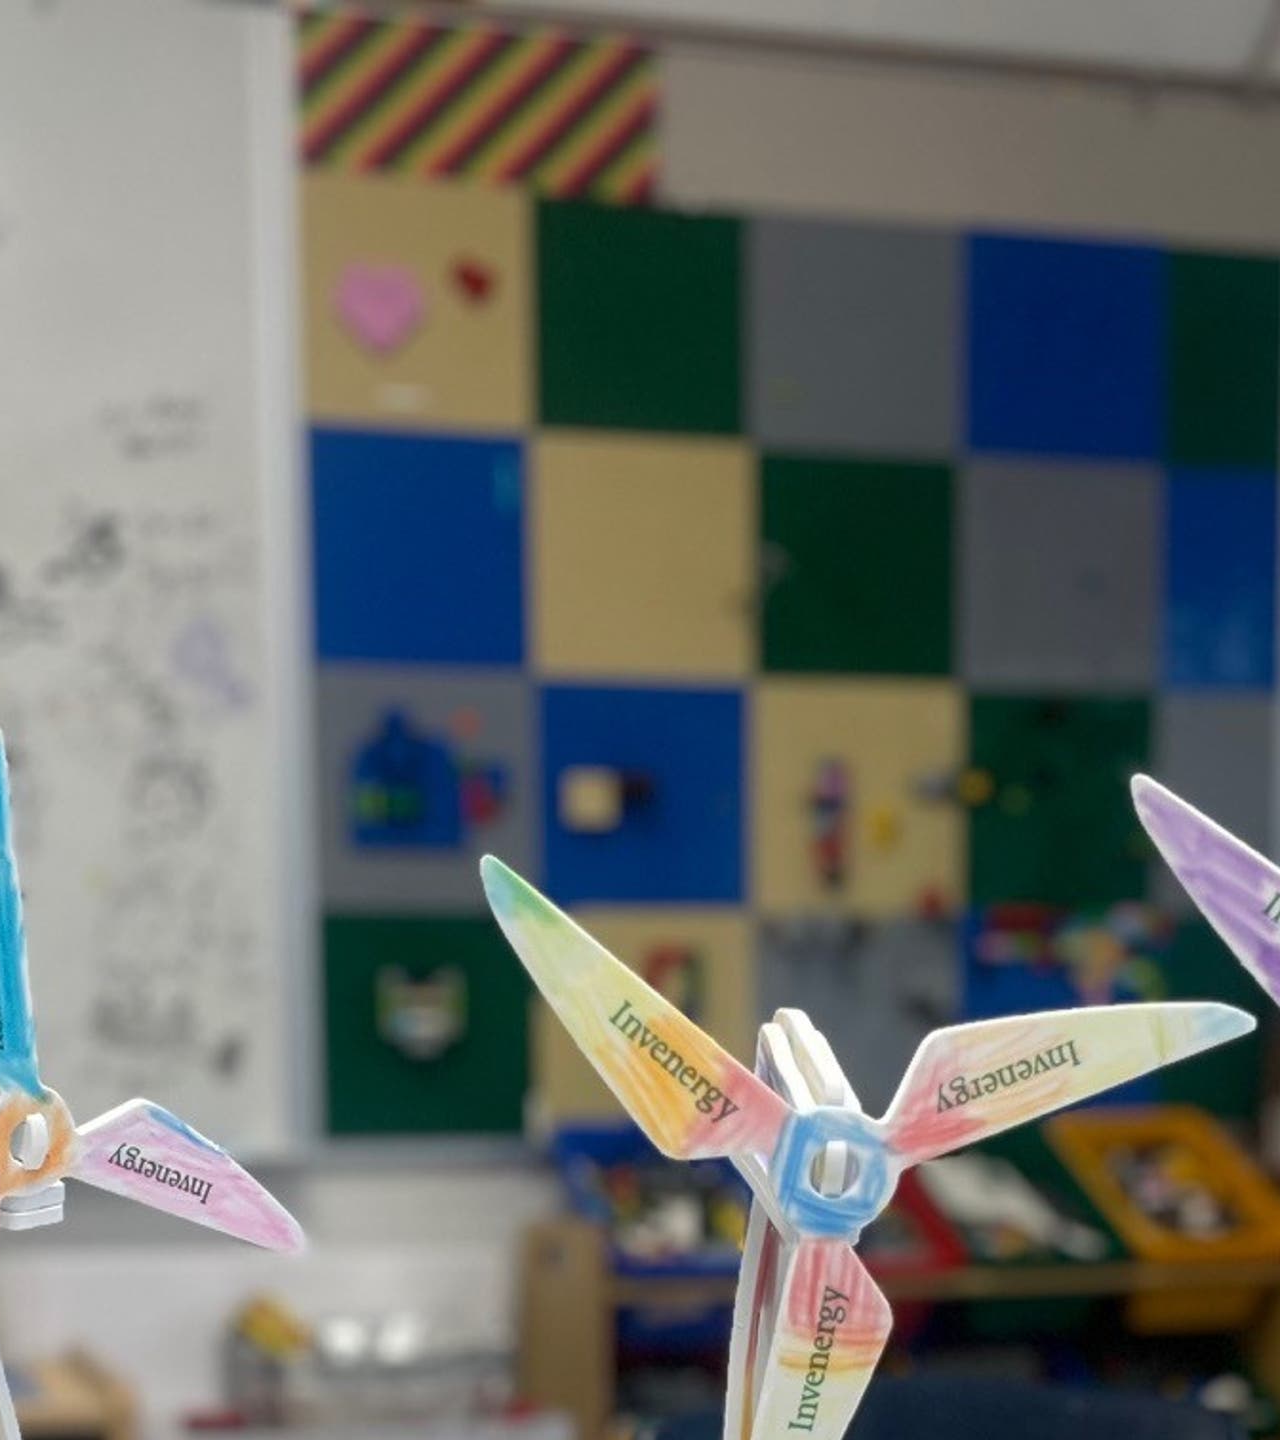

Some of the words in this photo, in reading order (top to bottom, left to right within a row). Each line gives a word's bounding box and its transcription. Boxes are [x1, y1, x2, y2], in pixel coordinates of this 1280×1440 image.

[609, 1000, 740, 1123] Invenergy
[936, 1039, 1081, 1114] Invenergy
[108, 1142, 213, 1205] Invenergy
[788, 1285, 850, 1432] Invenergy
